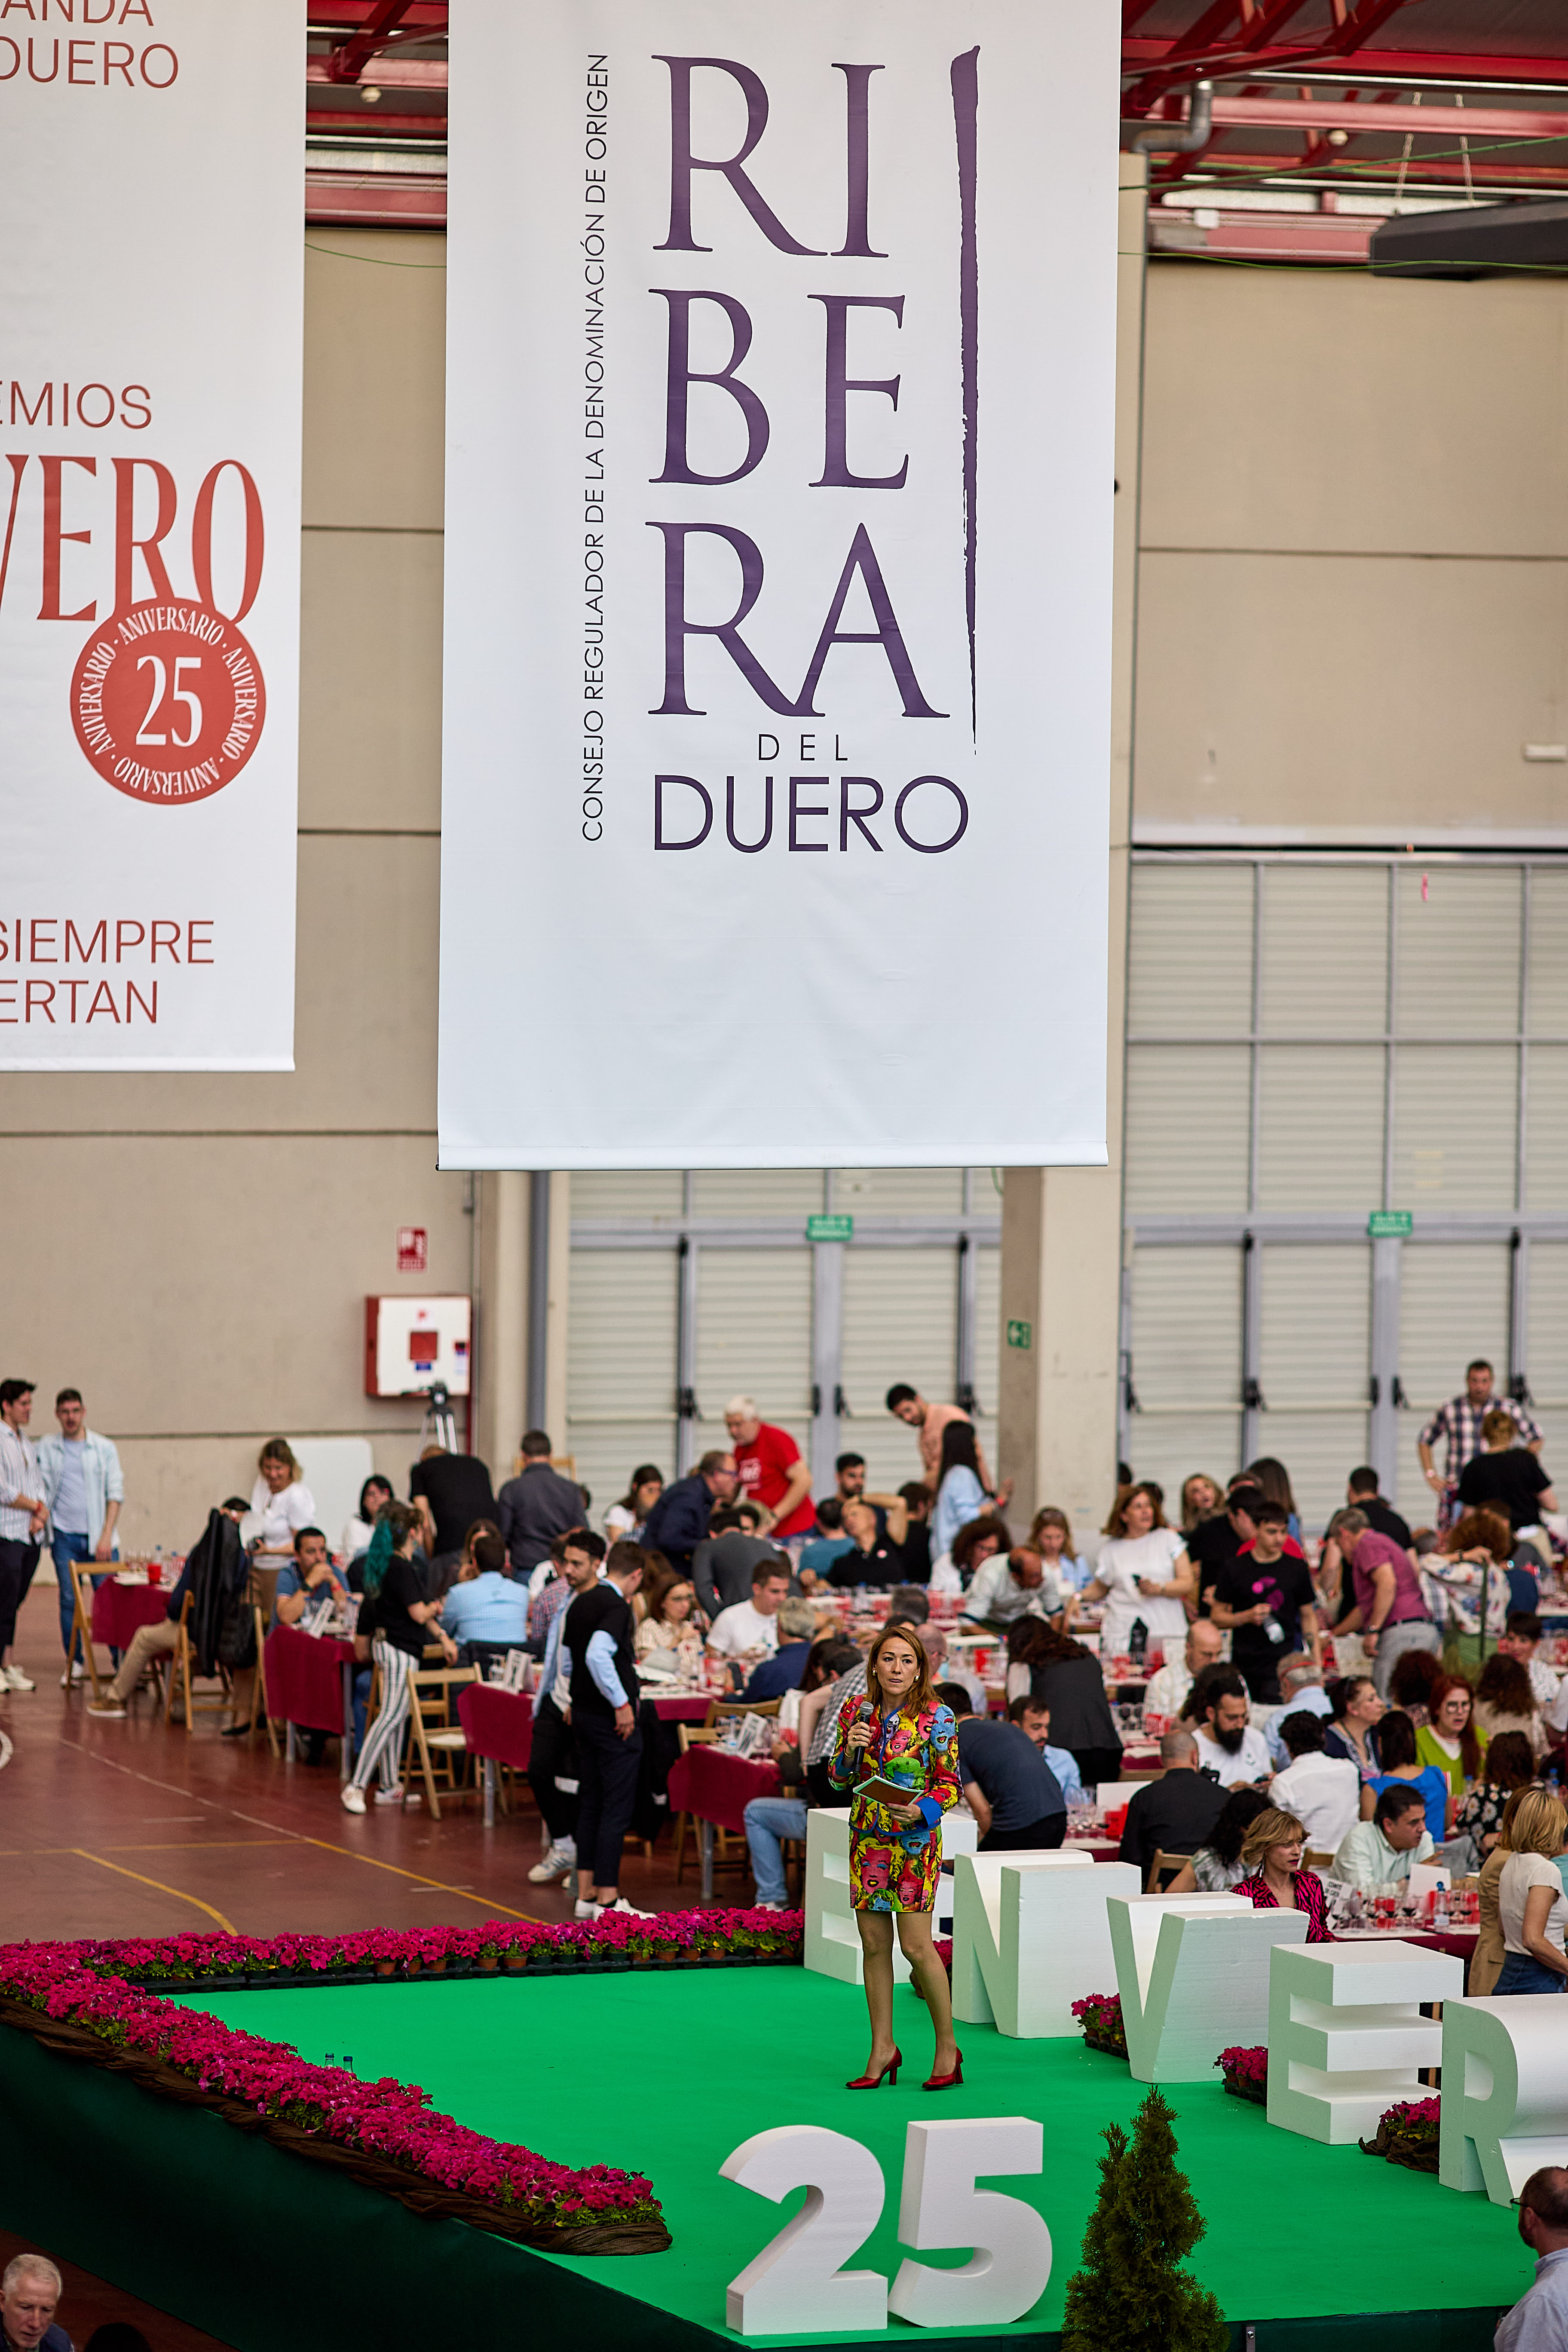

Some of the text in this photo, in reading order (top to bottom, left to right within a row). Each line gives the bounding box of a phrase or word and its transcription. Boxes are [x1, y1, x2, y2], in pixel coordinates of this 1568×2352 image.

[0, 381, 152, 429] MIOS
[580, 55, 608, 841] CONSEJO REGULADOR DE LA DENOMINACIÓN DE ORIGEN
[117, 606, 225, 646] ANIVERSARIO
[79, 642, 116, 756] ANIVERSARIO
[136, 655, 203, 747] 25
[222, 647, 257, 760] ANIVERSARIO
[114, 756, 220, 796] ANIVERSARIO
[759, 734, 848, 761] DEL
[654, 775, 969, 854] DUERO
[0, 919, 214, 964] IEMPRE
[717, 2116, 1053, 2336] 25
